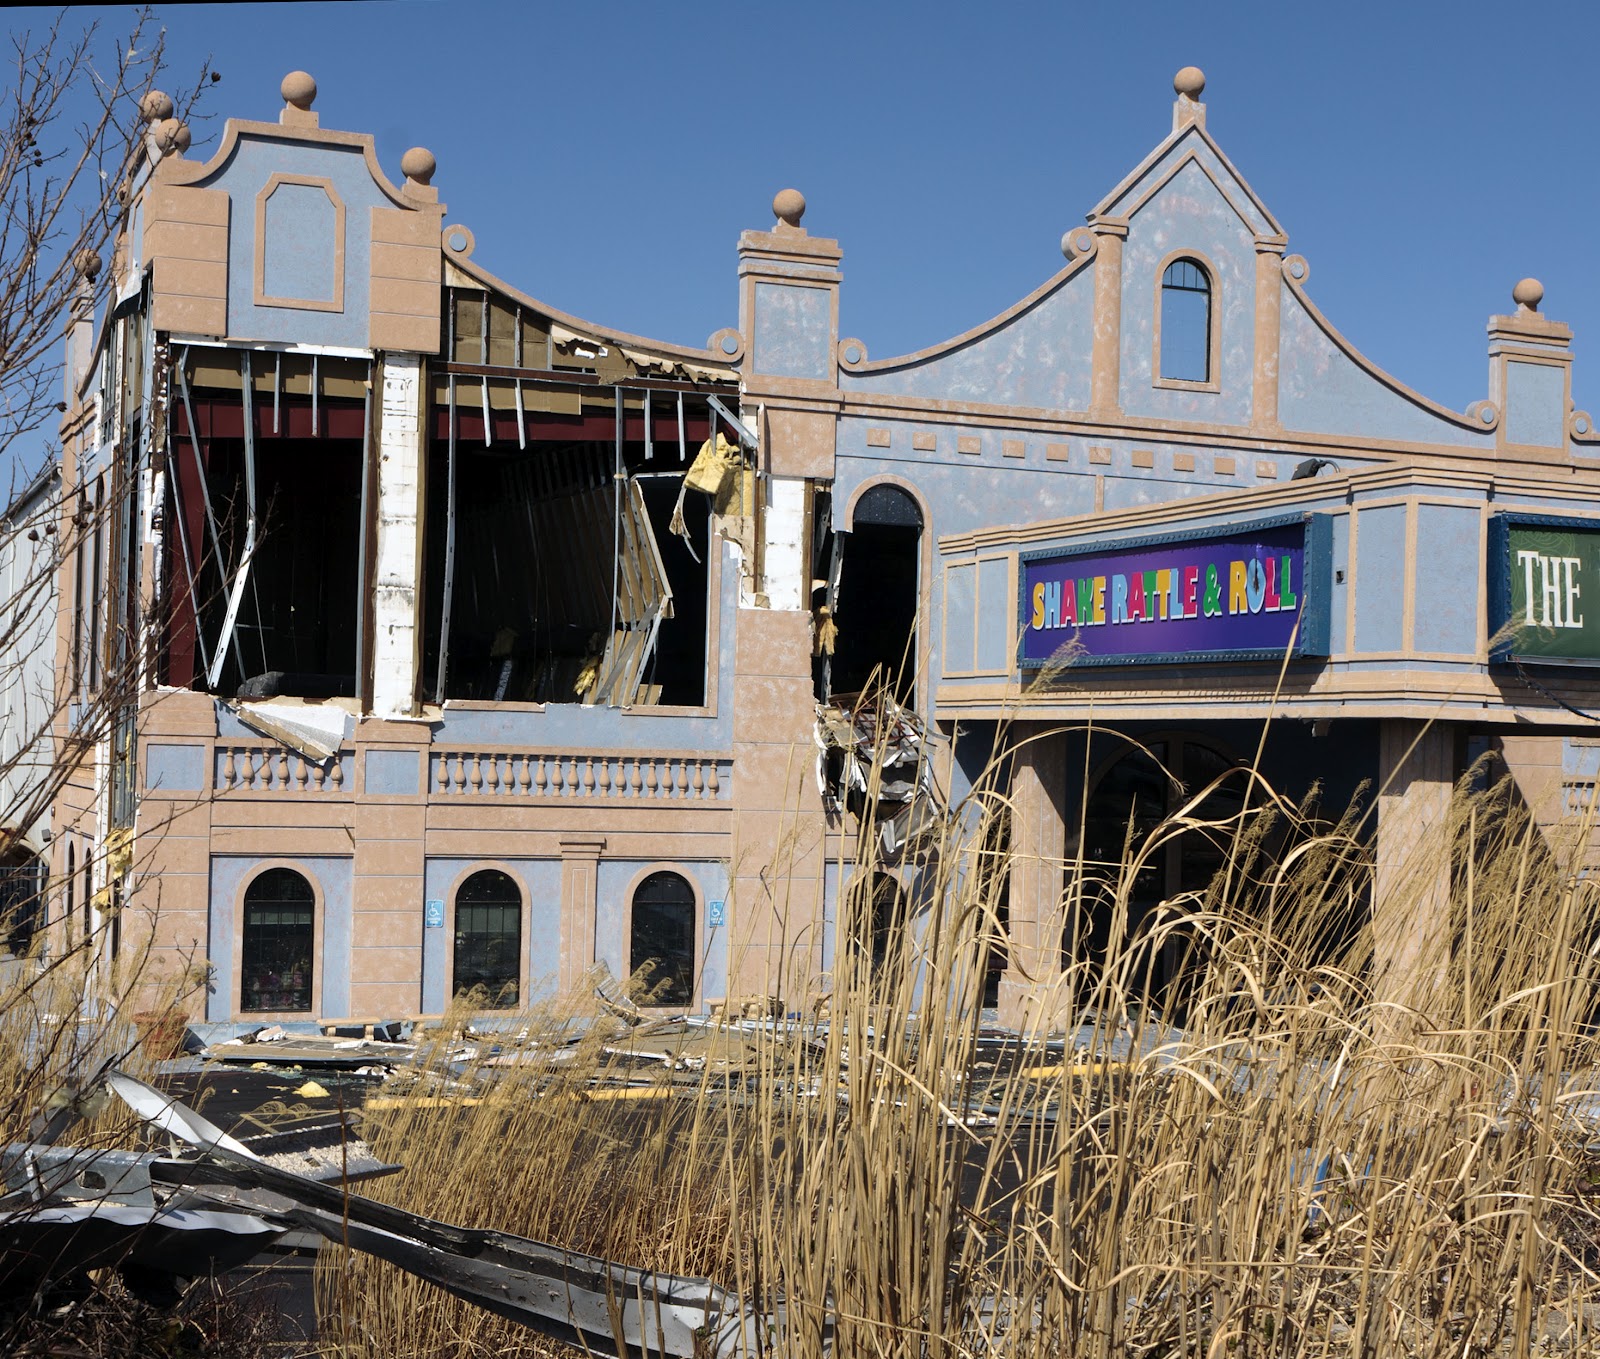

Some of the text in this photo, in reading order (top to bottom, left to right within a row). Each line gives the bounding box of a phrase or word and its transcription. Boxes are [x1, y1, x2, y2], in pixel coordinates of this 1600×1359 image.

[1032, 556, 1297, 631] SHAKE RATTLE & ROLL
[1517, 550, 1583, 629] THE
